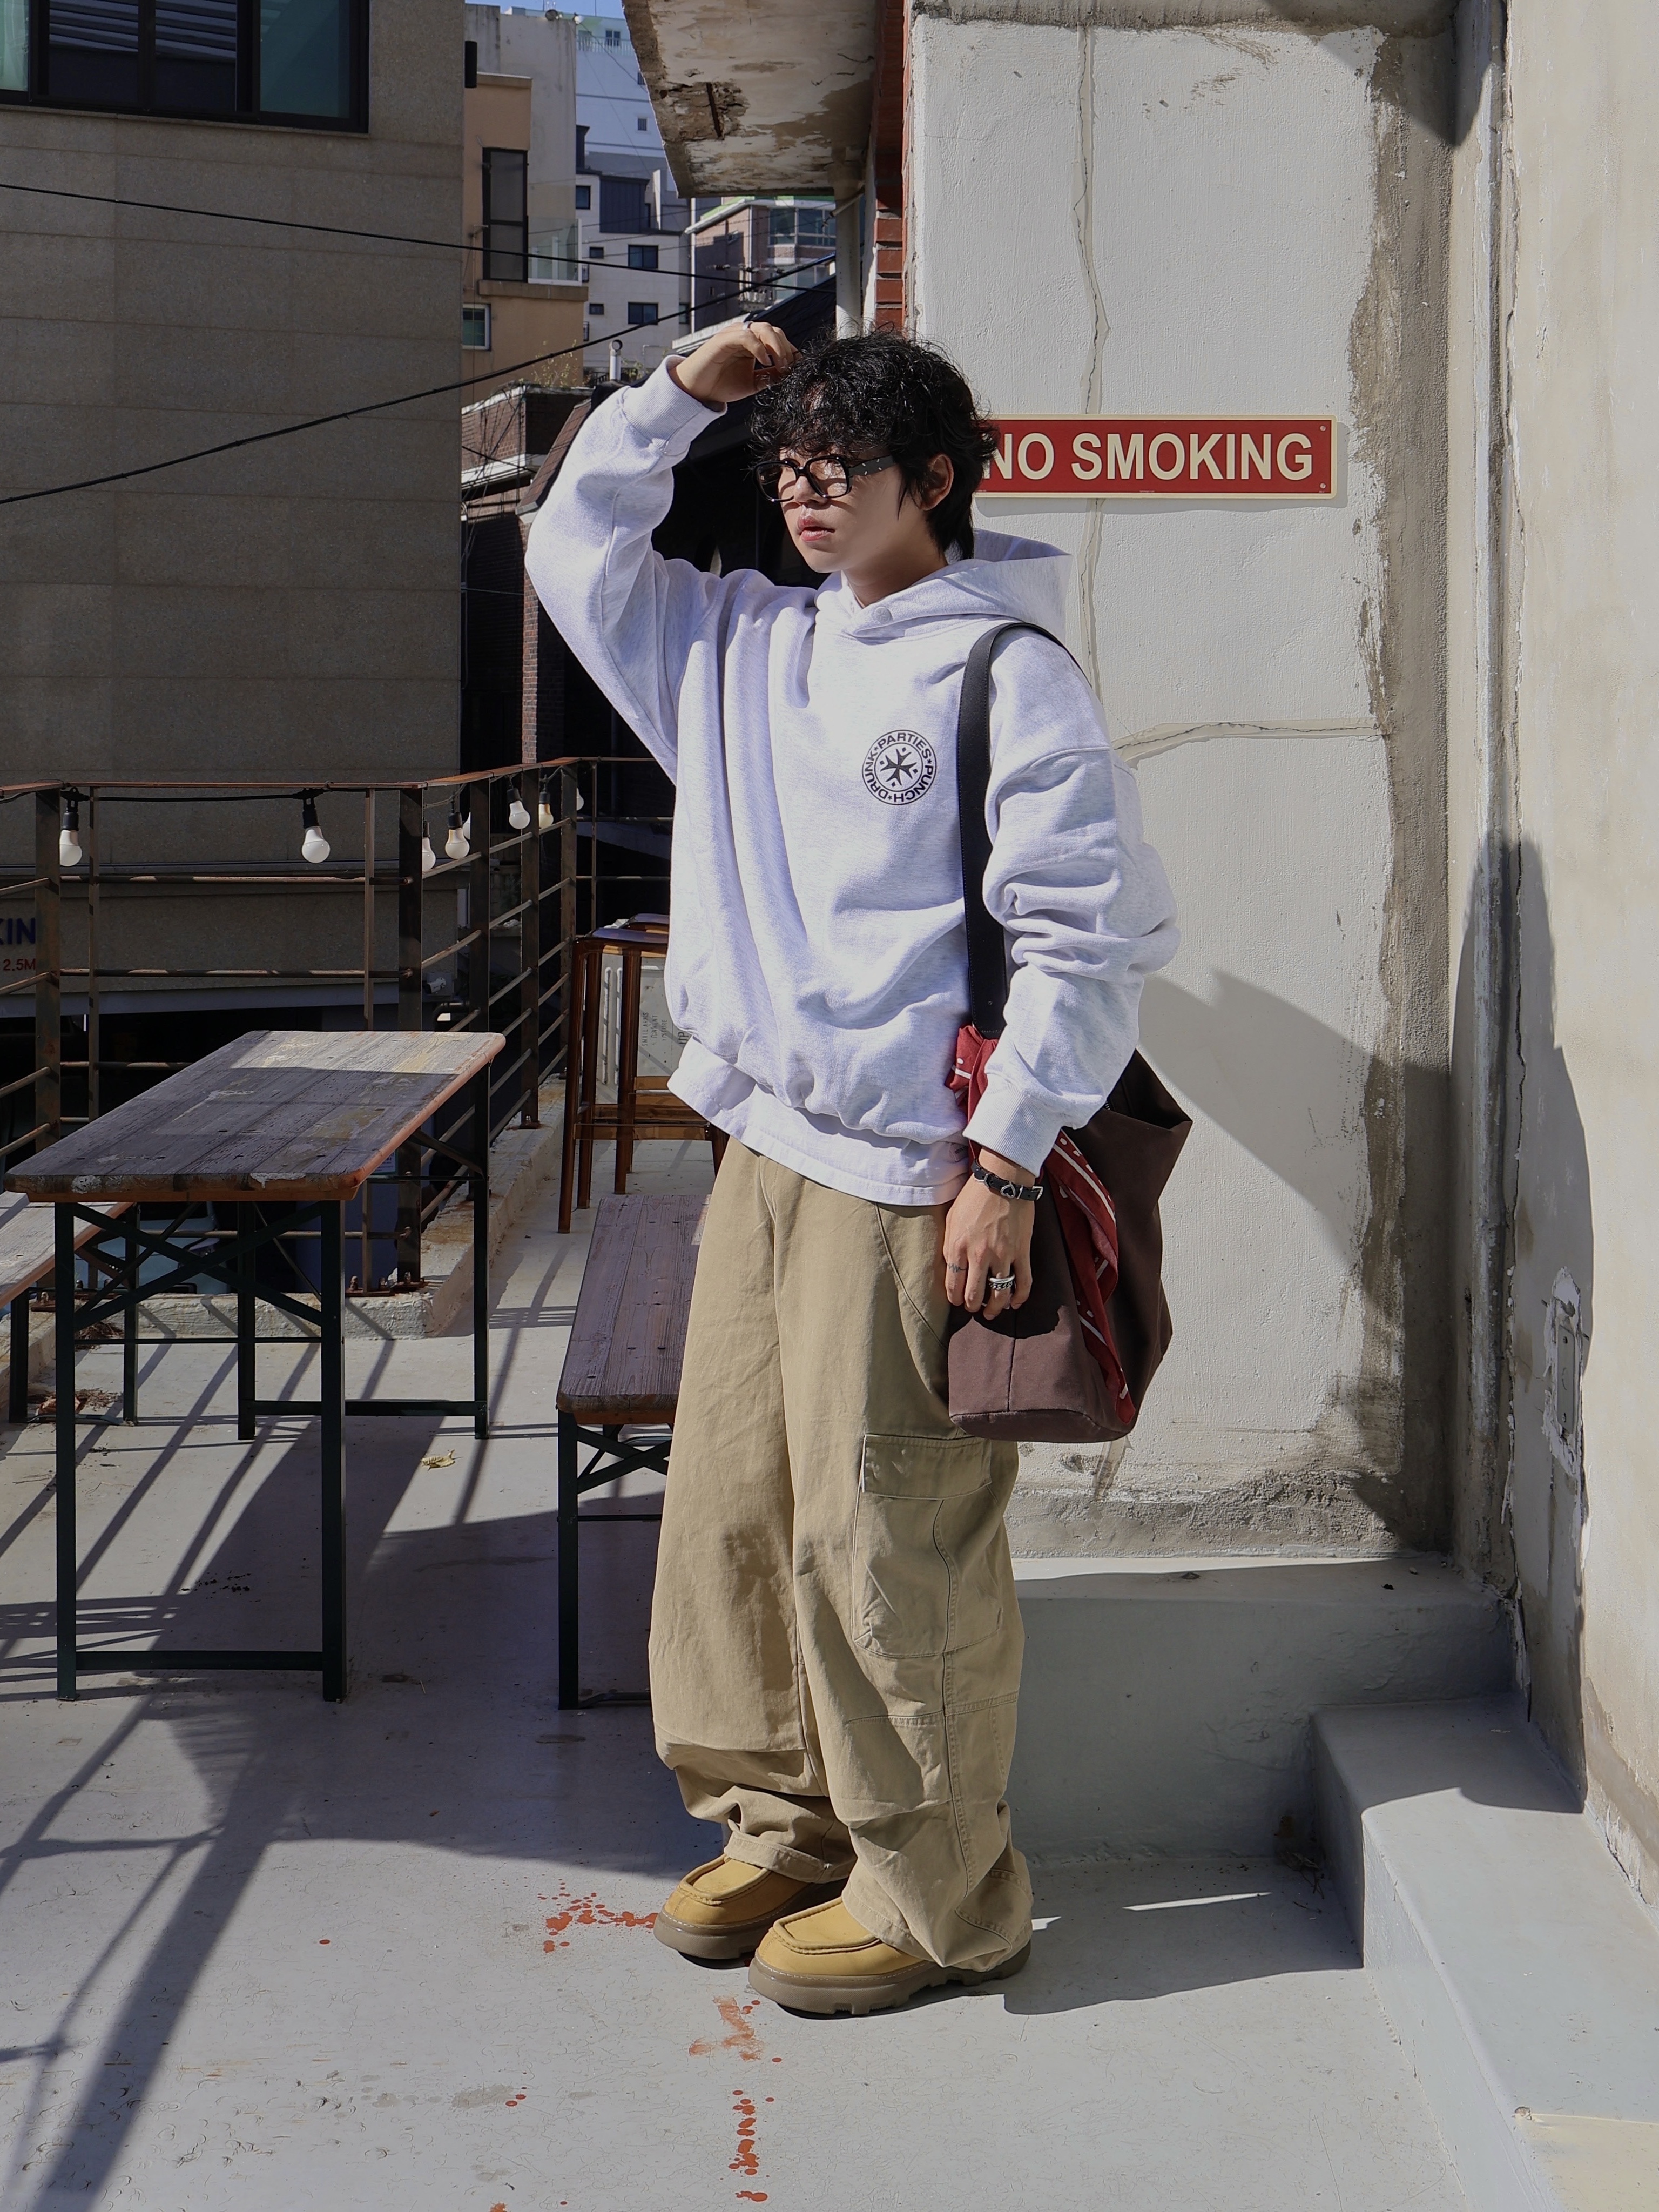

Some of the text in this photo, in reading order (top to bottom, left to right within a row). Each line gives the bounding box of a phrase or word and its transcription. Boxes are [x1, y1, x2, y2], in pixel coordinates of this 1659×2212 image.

[982, 433, 1313, 480] NO SMOKING
[865, 732, 934, 803] PARTIES PUNCH DRUNK
[3, 958, 36, 971] 2.5M
